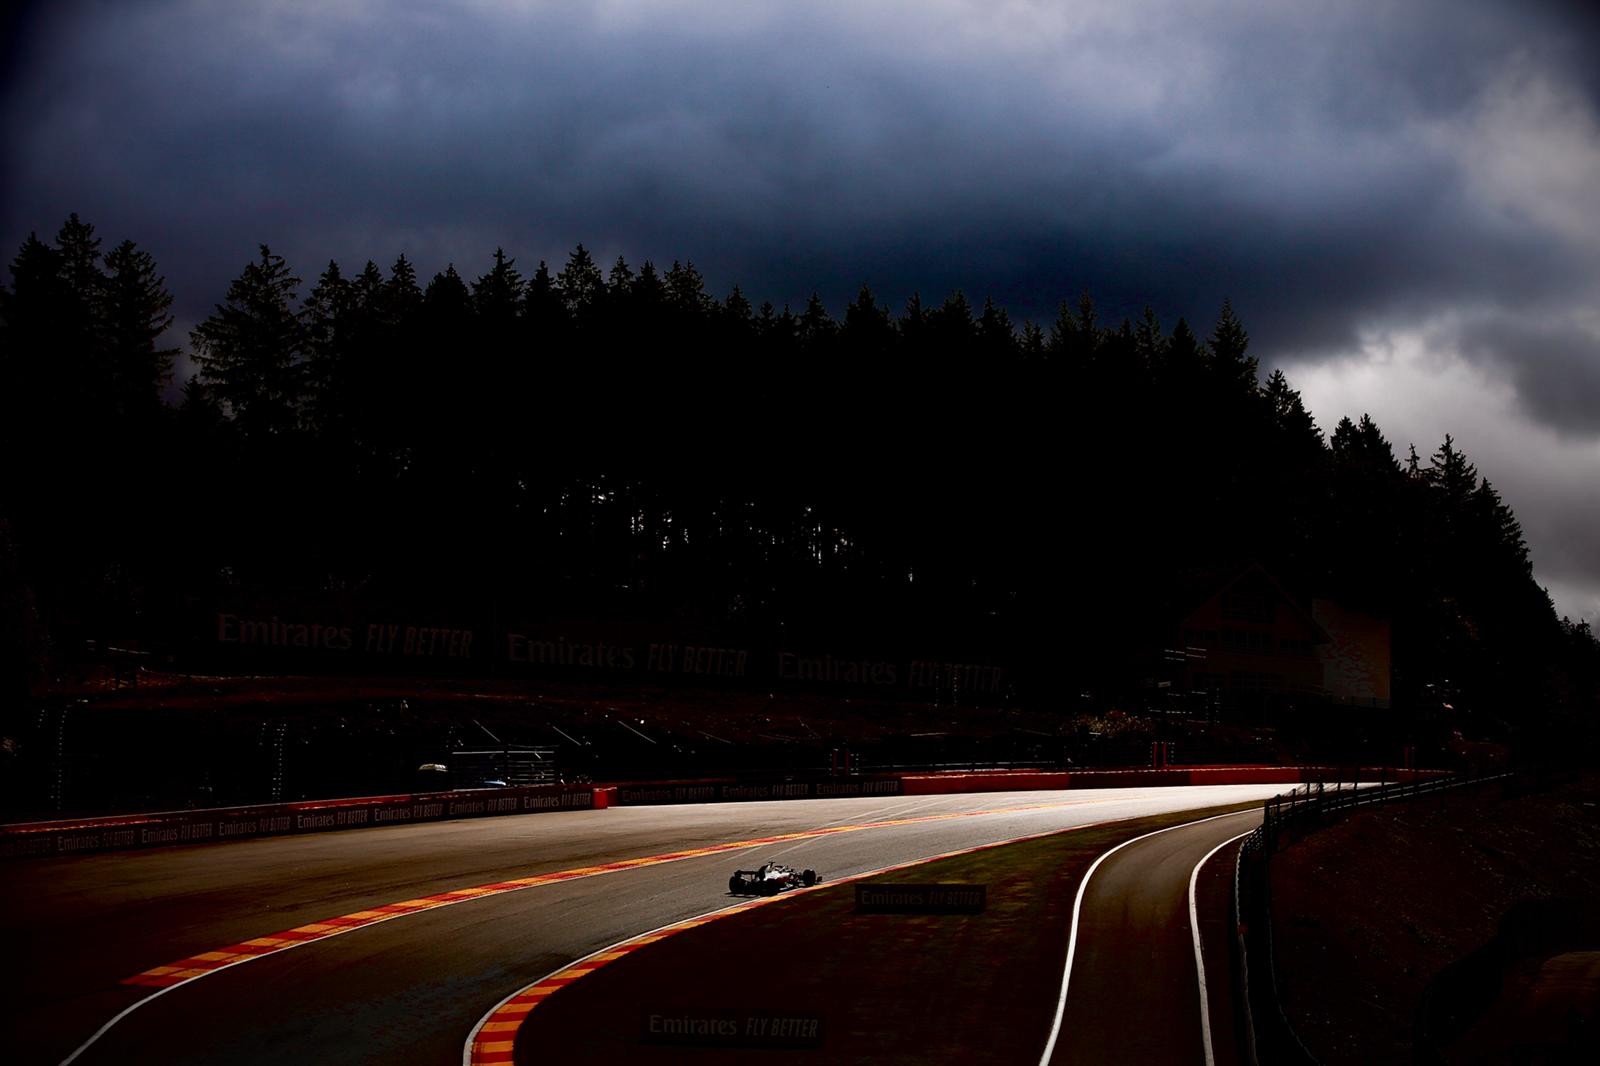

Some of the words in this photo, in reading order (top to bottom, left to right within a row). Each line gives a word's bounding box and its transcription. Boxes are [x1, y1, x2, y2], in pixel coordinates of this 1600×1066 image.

[218, 611, 352, 650] Emirates
[366, 623, 399, 652] FLY
[403, 627, 473, 659] BETTER
[507, 632, 636, 670] Emirates
[647, 641, 680, 671] FLY
[682, 645, 748, 677] BETTER
[777, 651, 897, 686] Emirates
[622, 789, 672, 802] Emirates
[721, 786, 768, 799] Emirates
[816, 783, 859, 796] Emirates
[449, 801, 485, 816] Emirates
[523, 796, 560, 809] Emirates
[297, 814, 335, 829] Emirates
[374, 808, 411, 822] Emirates
[141, 827, 178, 843] Emirates
[219, 821, 257, 837] Emirates
[862, 891, 924, 905] Emirates
[928, 891, 944, 905] FLY
[946, 891, 982, 905] BETTER
[650, 1014, 738, 1035] Emirates
[745, 1017, 768, 1037] FLY
[770, 1018, 818, 1038] BETTER
